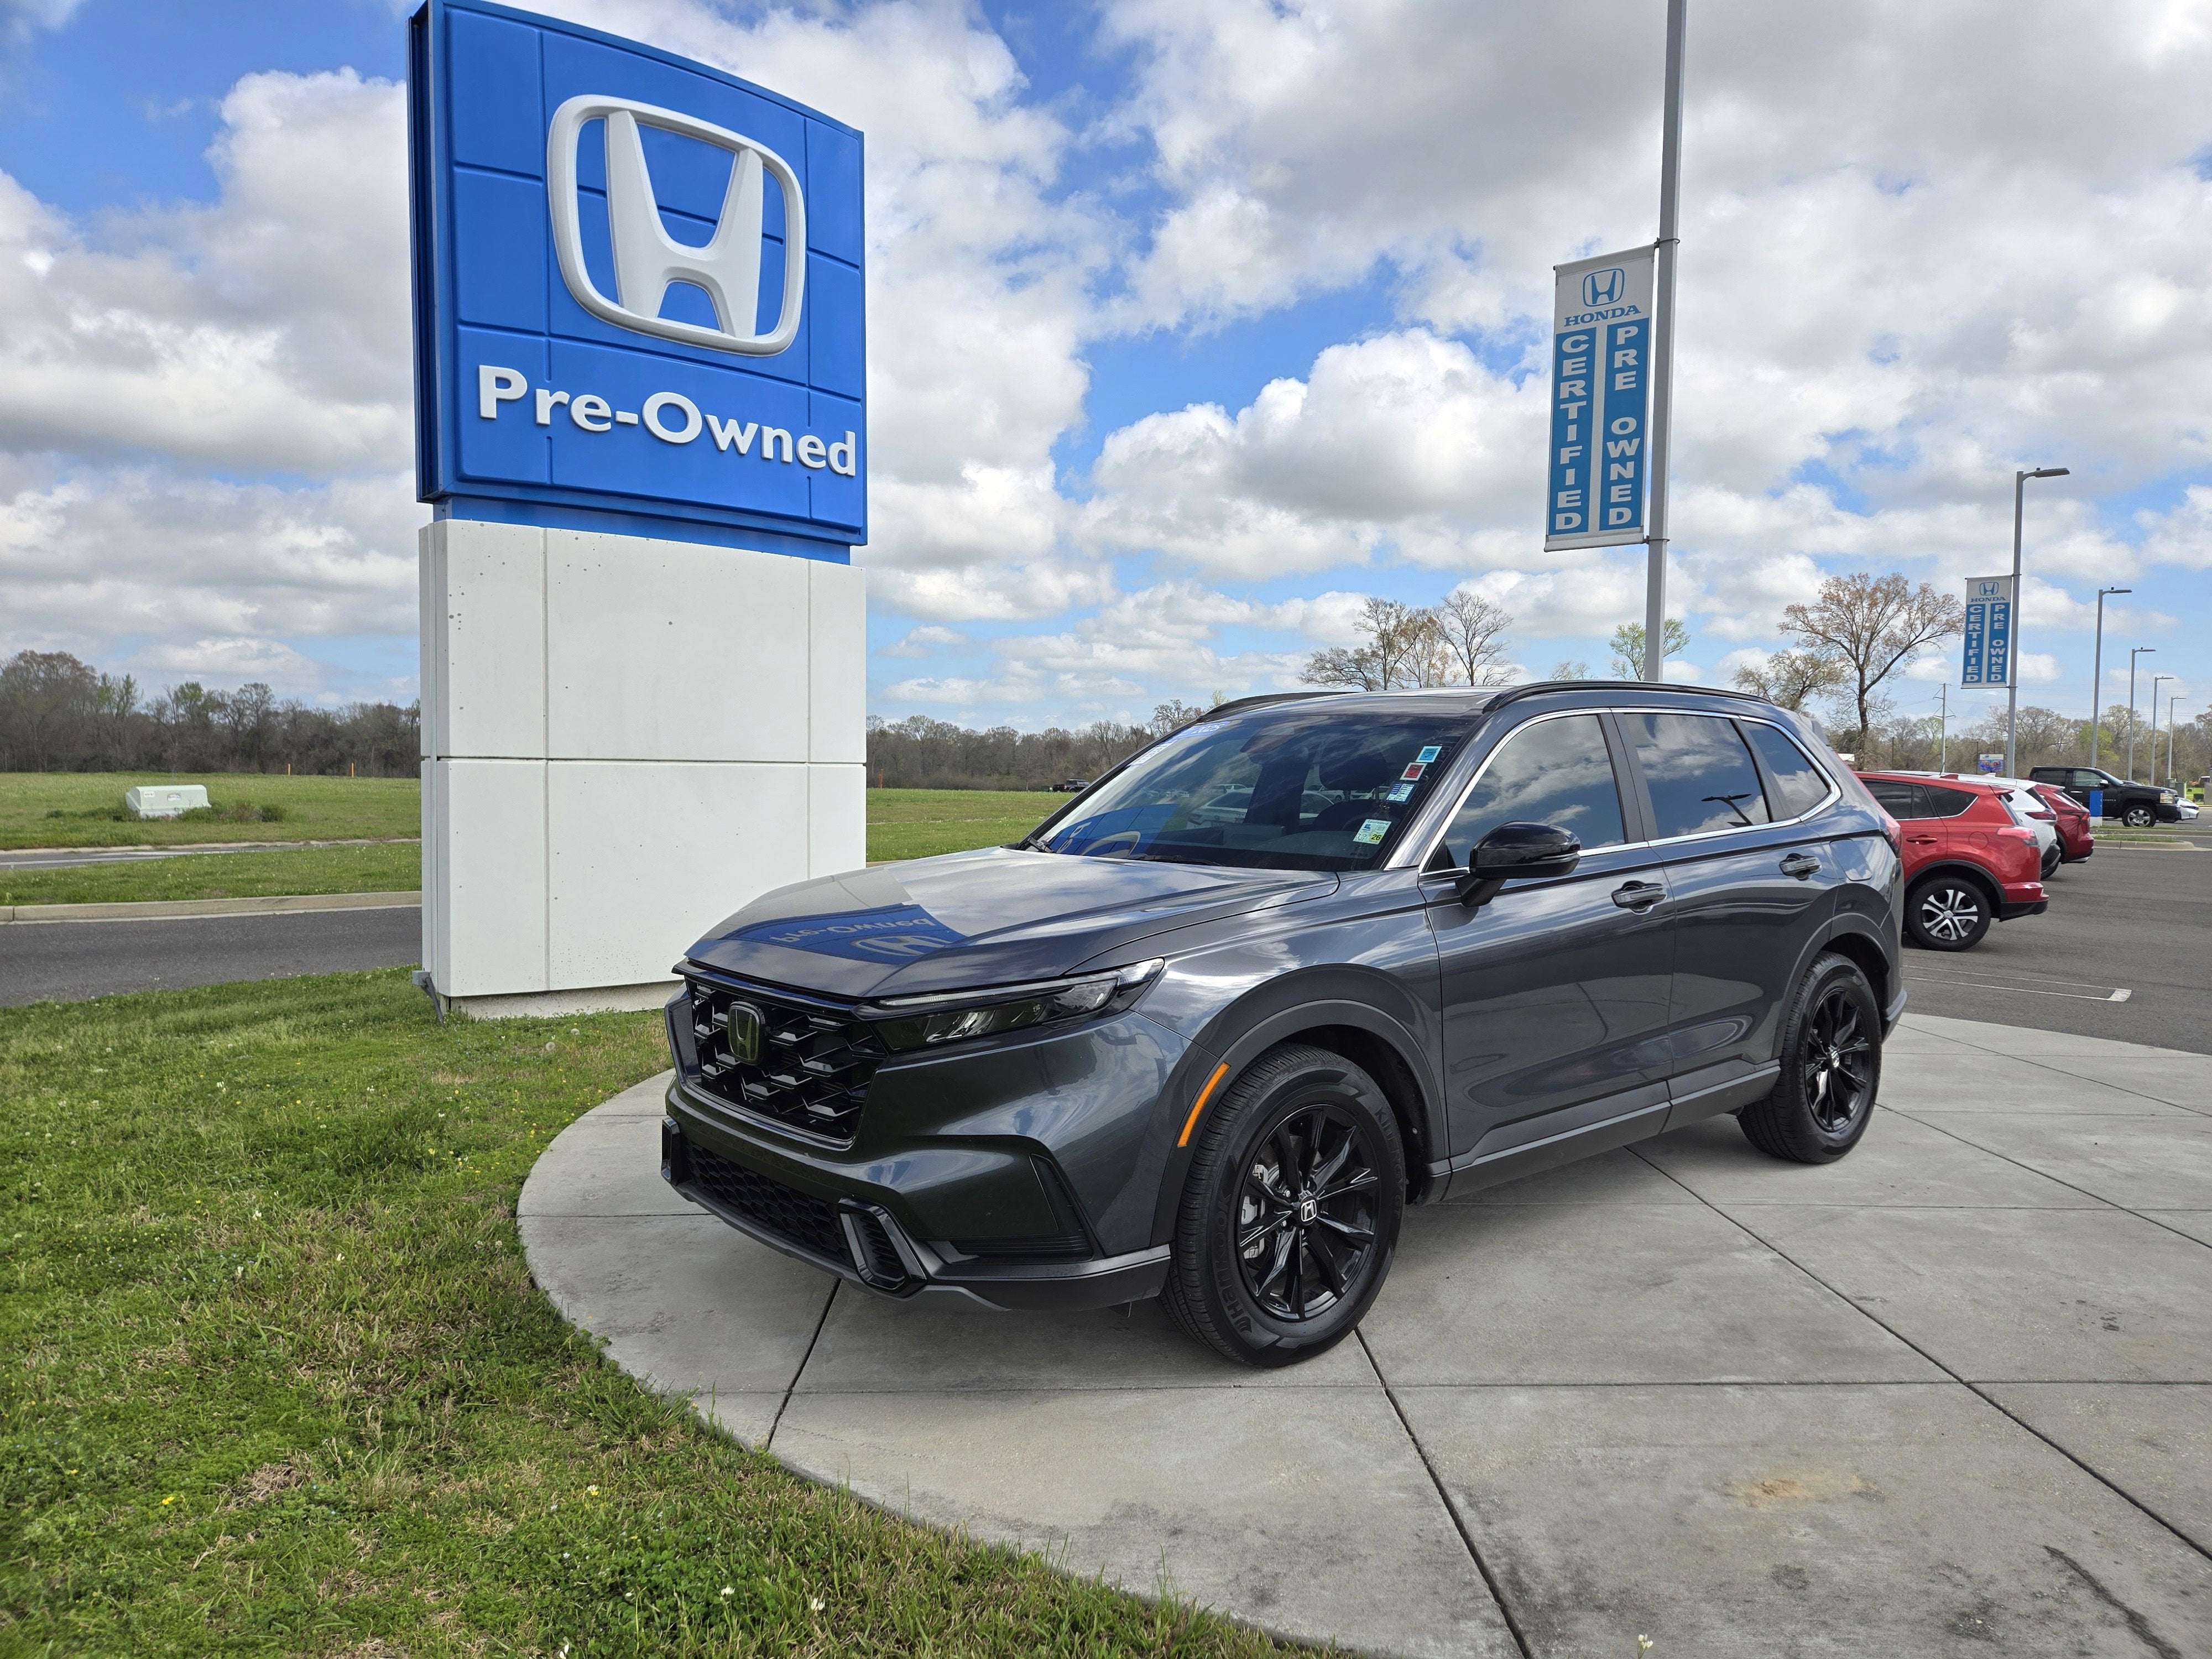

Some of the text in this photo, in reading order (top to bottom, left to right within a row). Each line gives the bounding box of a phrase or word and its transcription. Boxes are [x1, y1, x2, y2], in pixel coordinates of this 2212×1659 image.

[1564, 305, 1641, 327] HONDA
[478, 364, 856, 477] Pre-Owned
[1555, 335, 1590, 530] CERTIFIED
[1606, 326, 1641, 525] PRE OWNED
[1966, 606, 1982, 682] CERTIFIED
[1990, 604, 2006, 681] PRE OWNED
